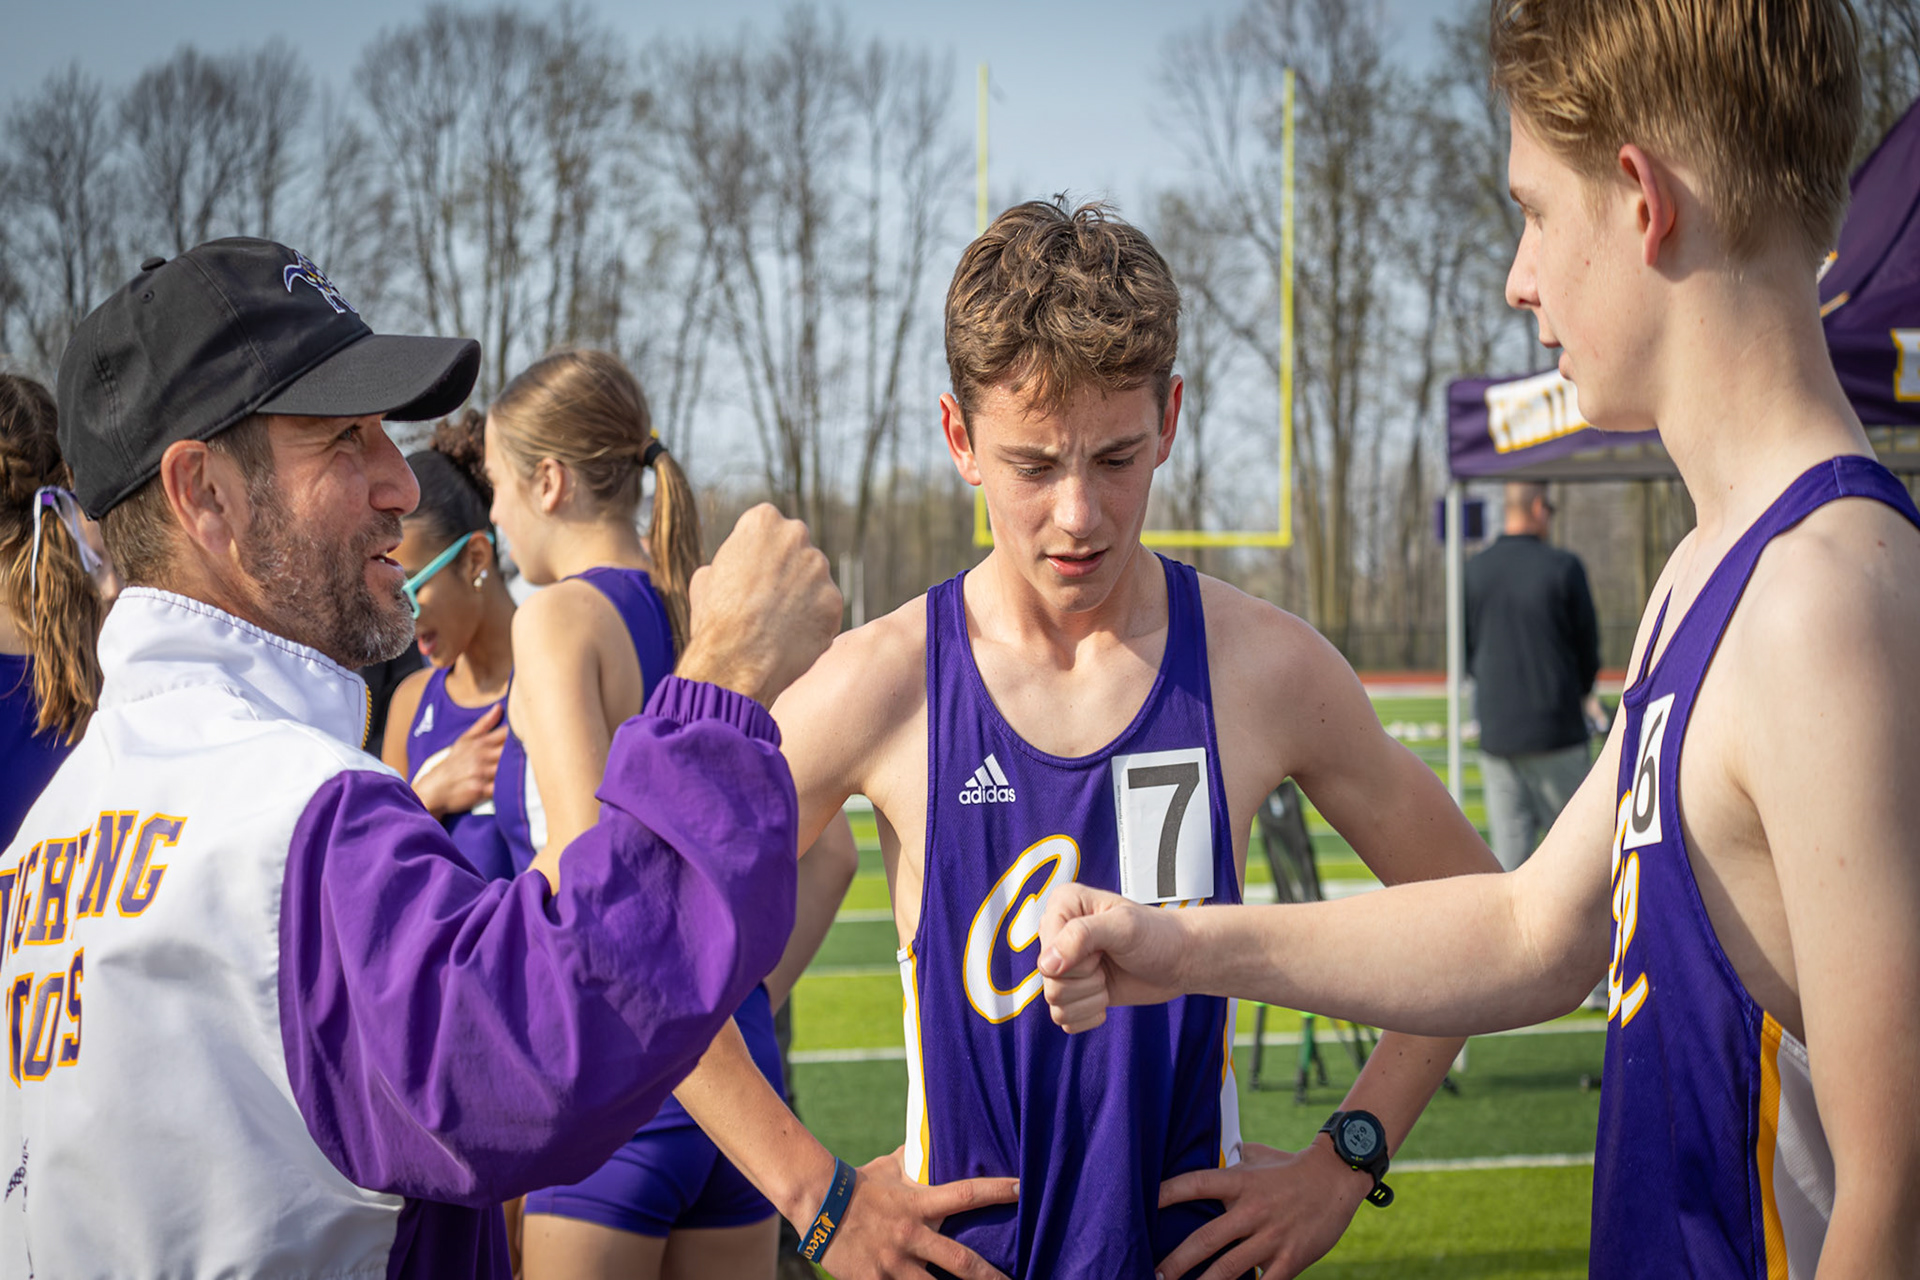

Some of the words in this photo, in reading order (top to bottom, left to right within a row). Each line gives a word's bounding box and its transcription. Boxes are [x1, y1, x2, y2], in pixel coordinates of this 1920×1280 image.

[958, 785, 1016, 805] adidas
[1127, 761, 1200, 898] 7
[1632, 710, 1664, 834] 6
